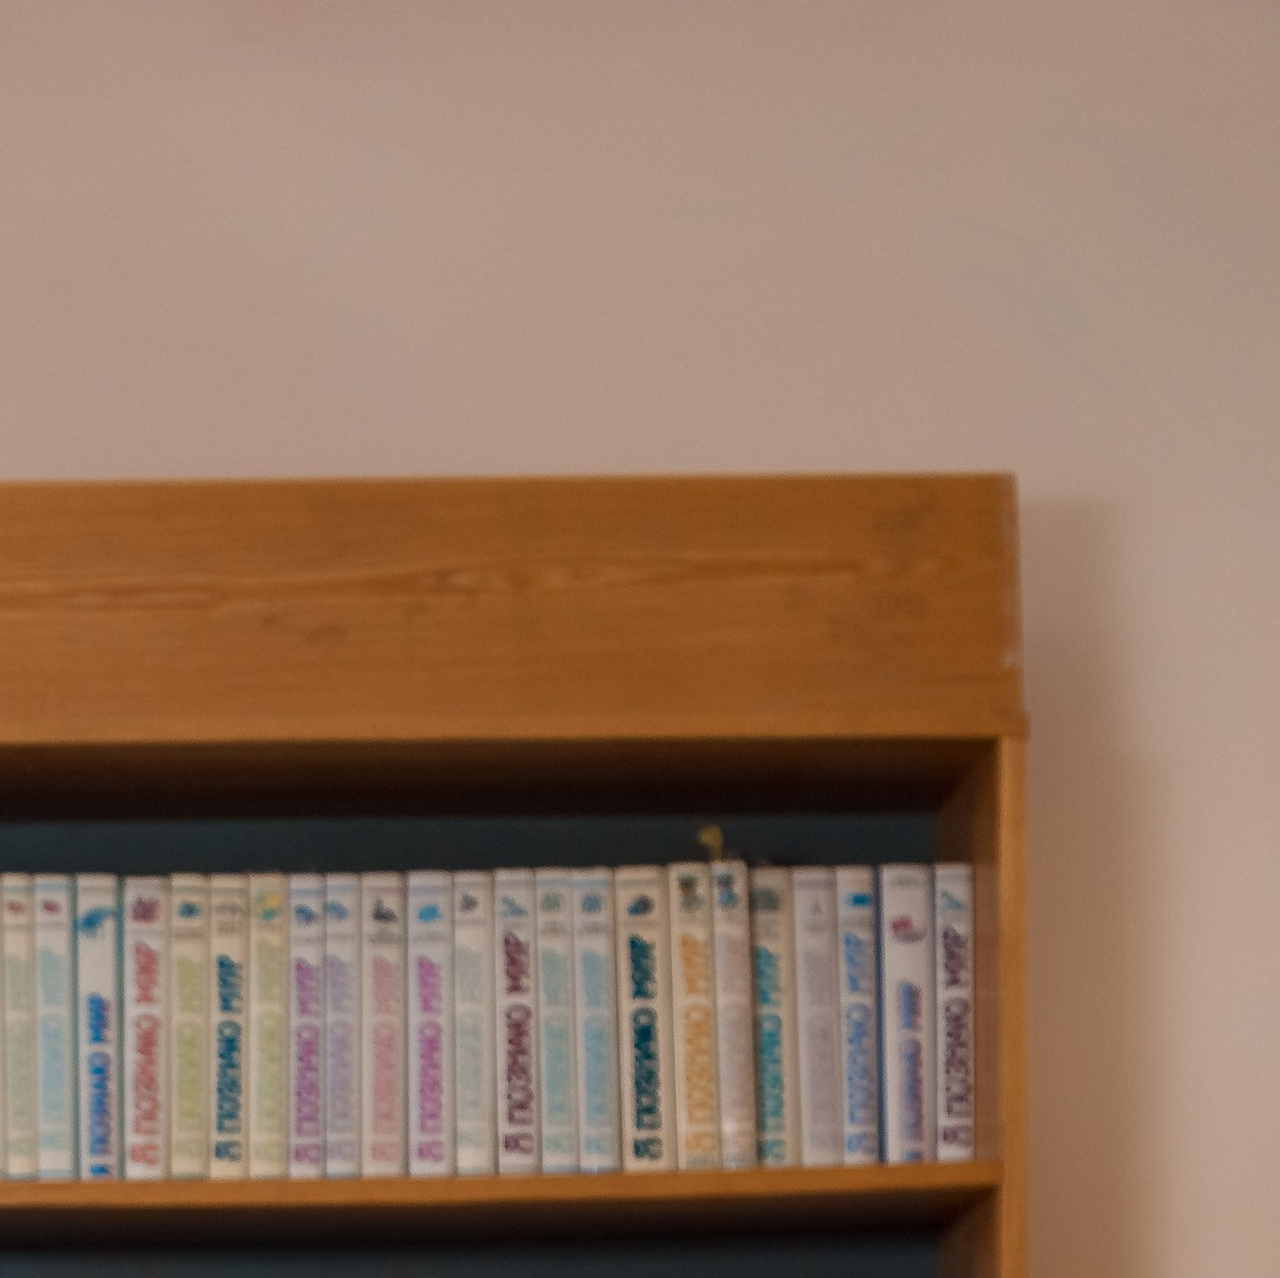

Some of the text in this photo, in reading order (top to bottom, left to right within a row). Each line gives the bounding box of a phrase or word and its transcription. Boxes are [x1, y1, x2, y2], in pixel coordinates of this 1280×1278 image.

[217, 954, 241, 1014] МИР
[504, 931, 530, 995] МИР
[629, 934, 656, 1000] МИР
[217, 1020, 241, 1134] ПОЗНАЮ
[506, 1003, 534, 1126] ПОЗНАЮ
[633, 1007, 662, 1131] ПОЗНАЮ
